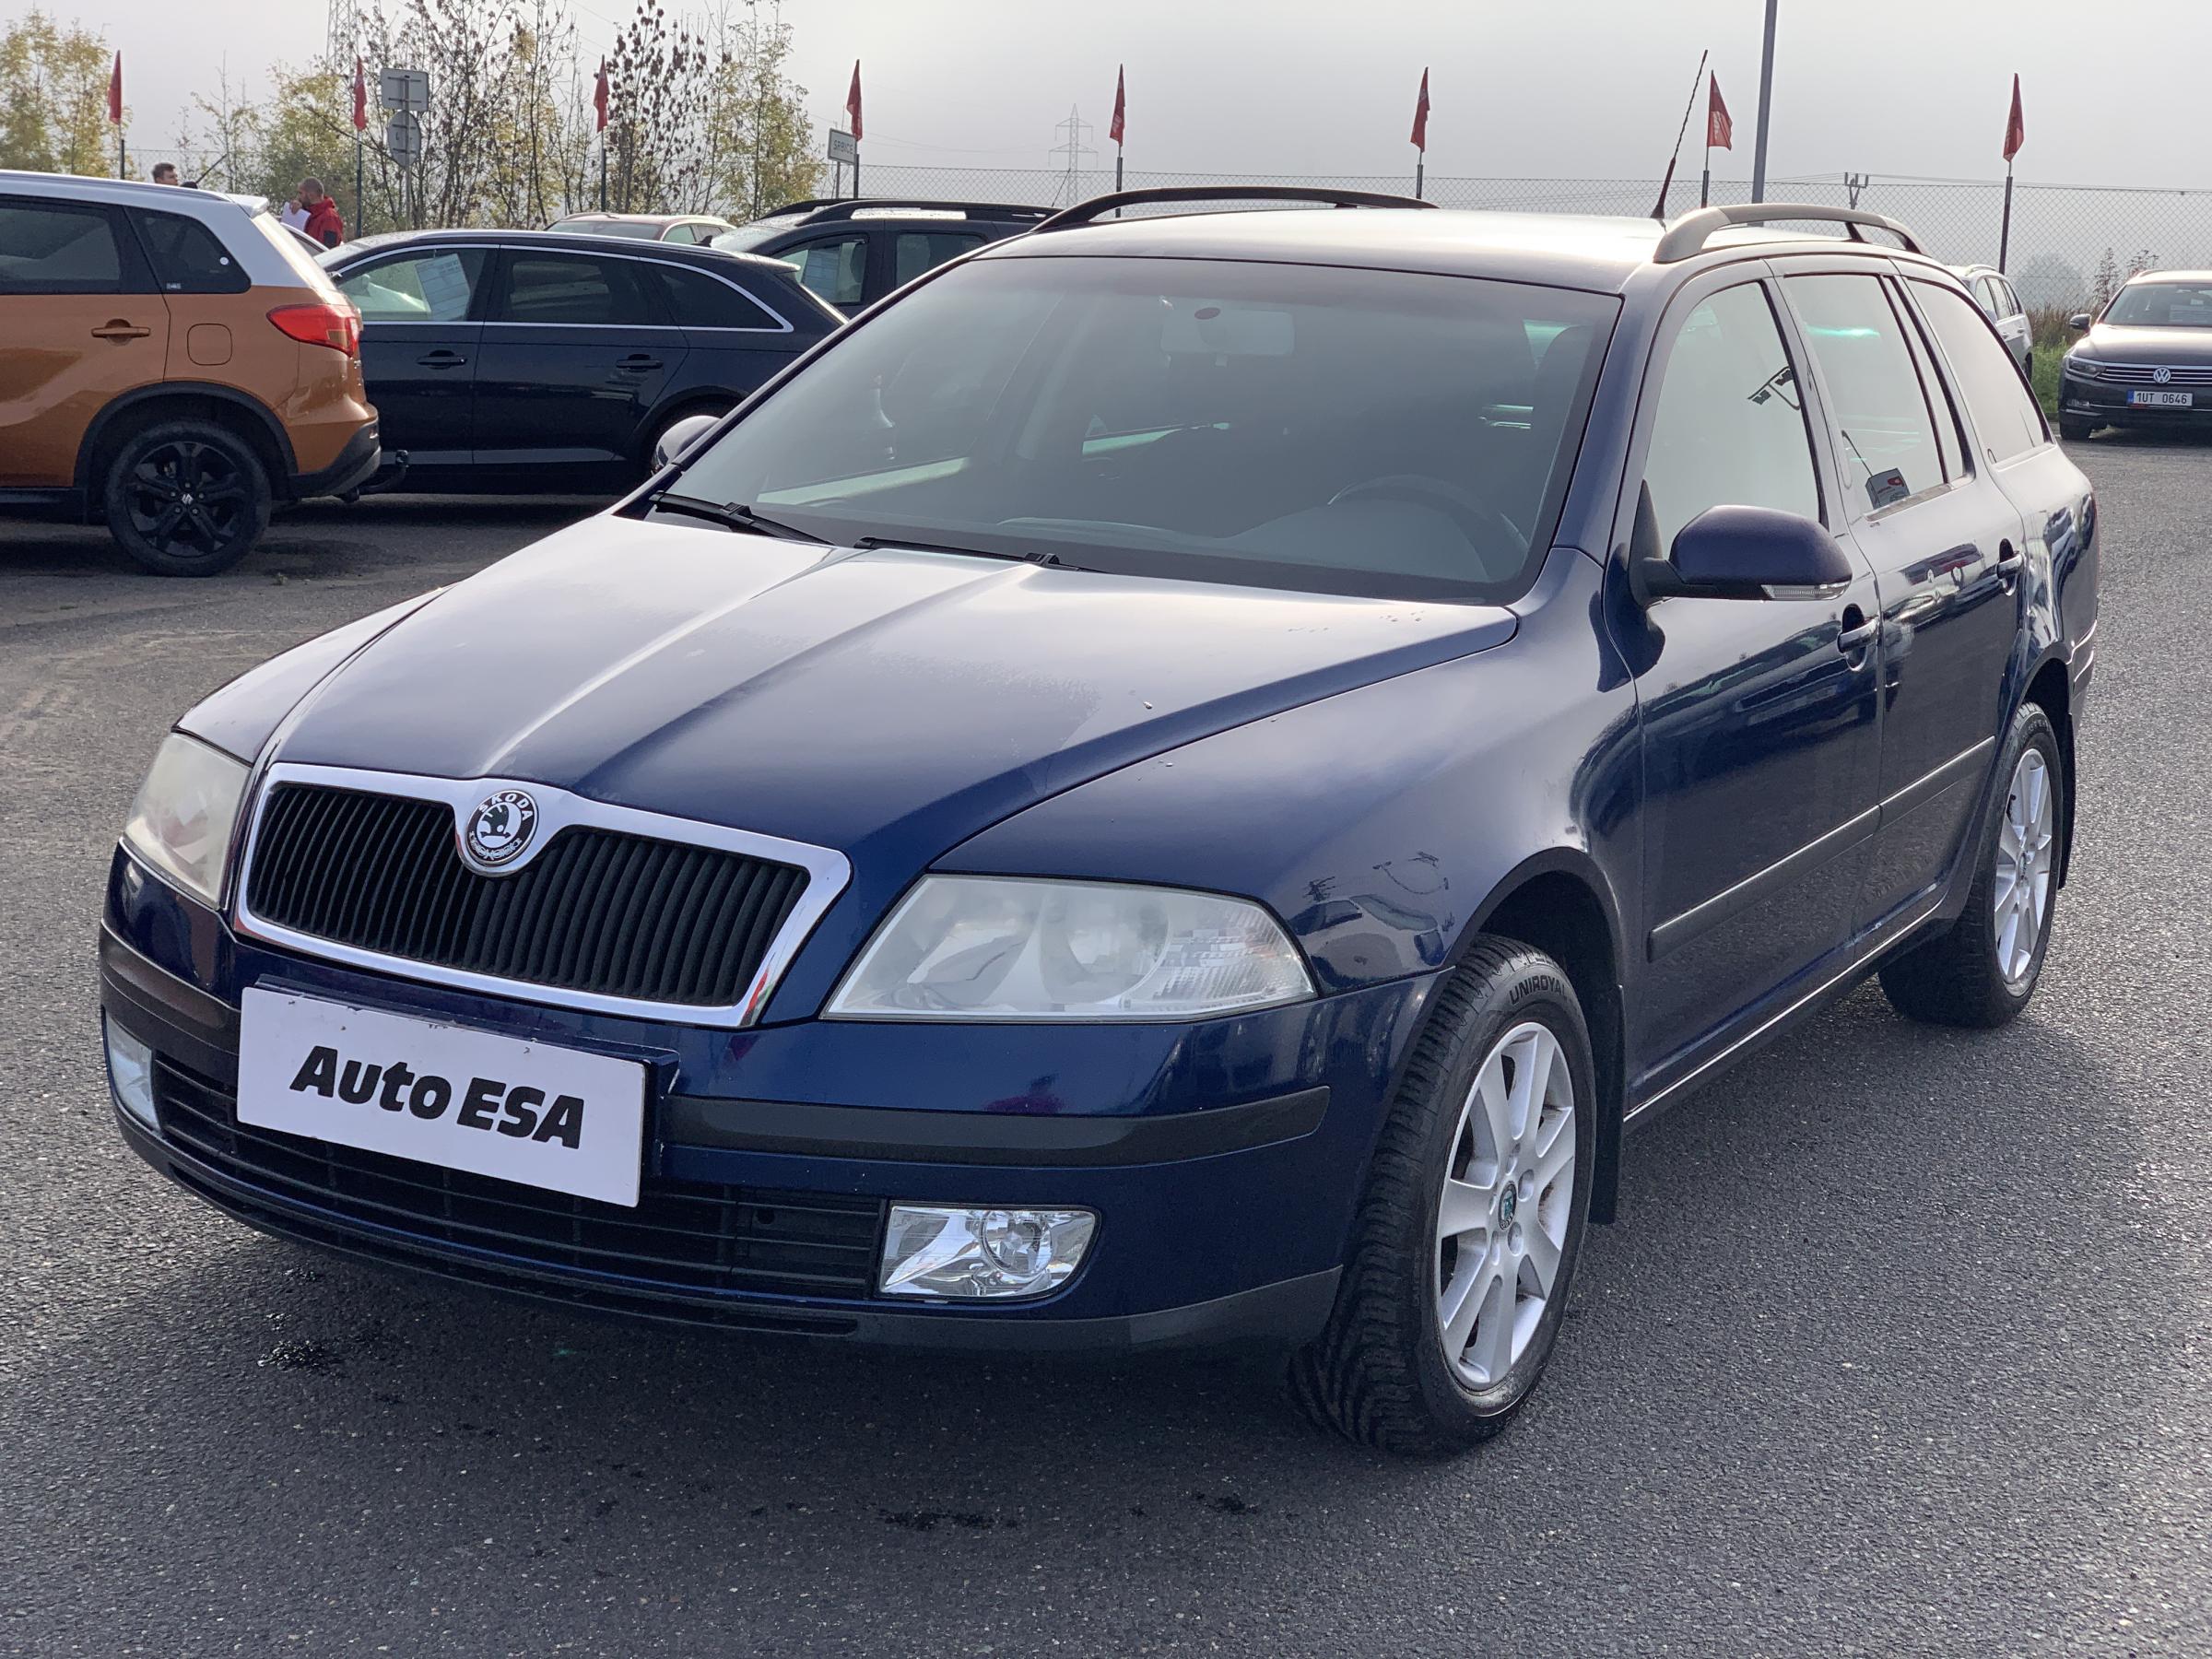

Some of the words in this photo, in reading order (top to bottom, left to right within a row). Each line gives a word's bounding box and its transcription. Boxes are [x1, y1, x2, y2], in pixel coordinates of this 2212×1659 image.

[2136, 392, 2155, 403] 1UT
[2162, 394, 2188, 404] 0646
[289, 1045, 452, 1120] Auto
[456, 1077, 584, 1149] ESA
